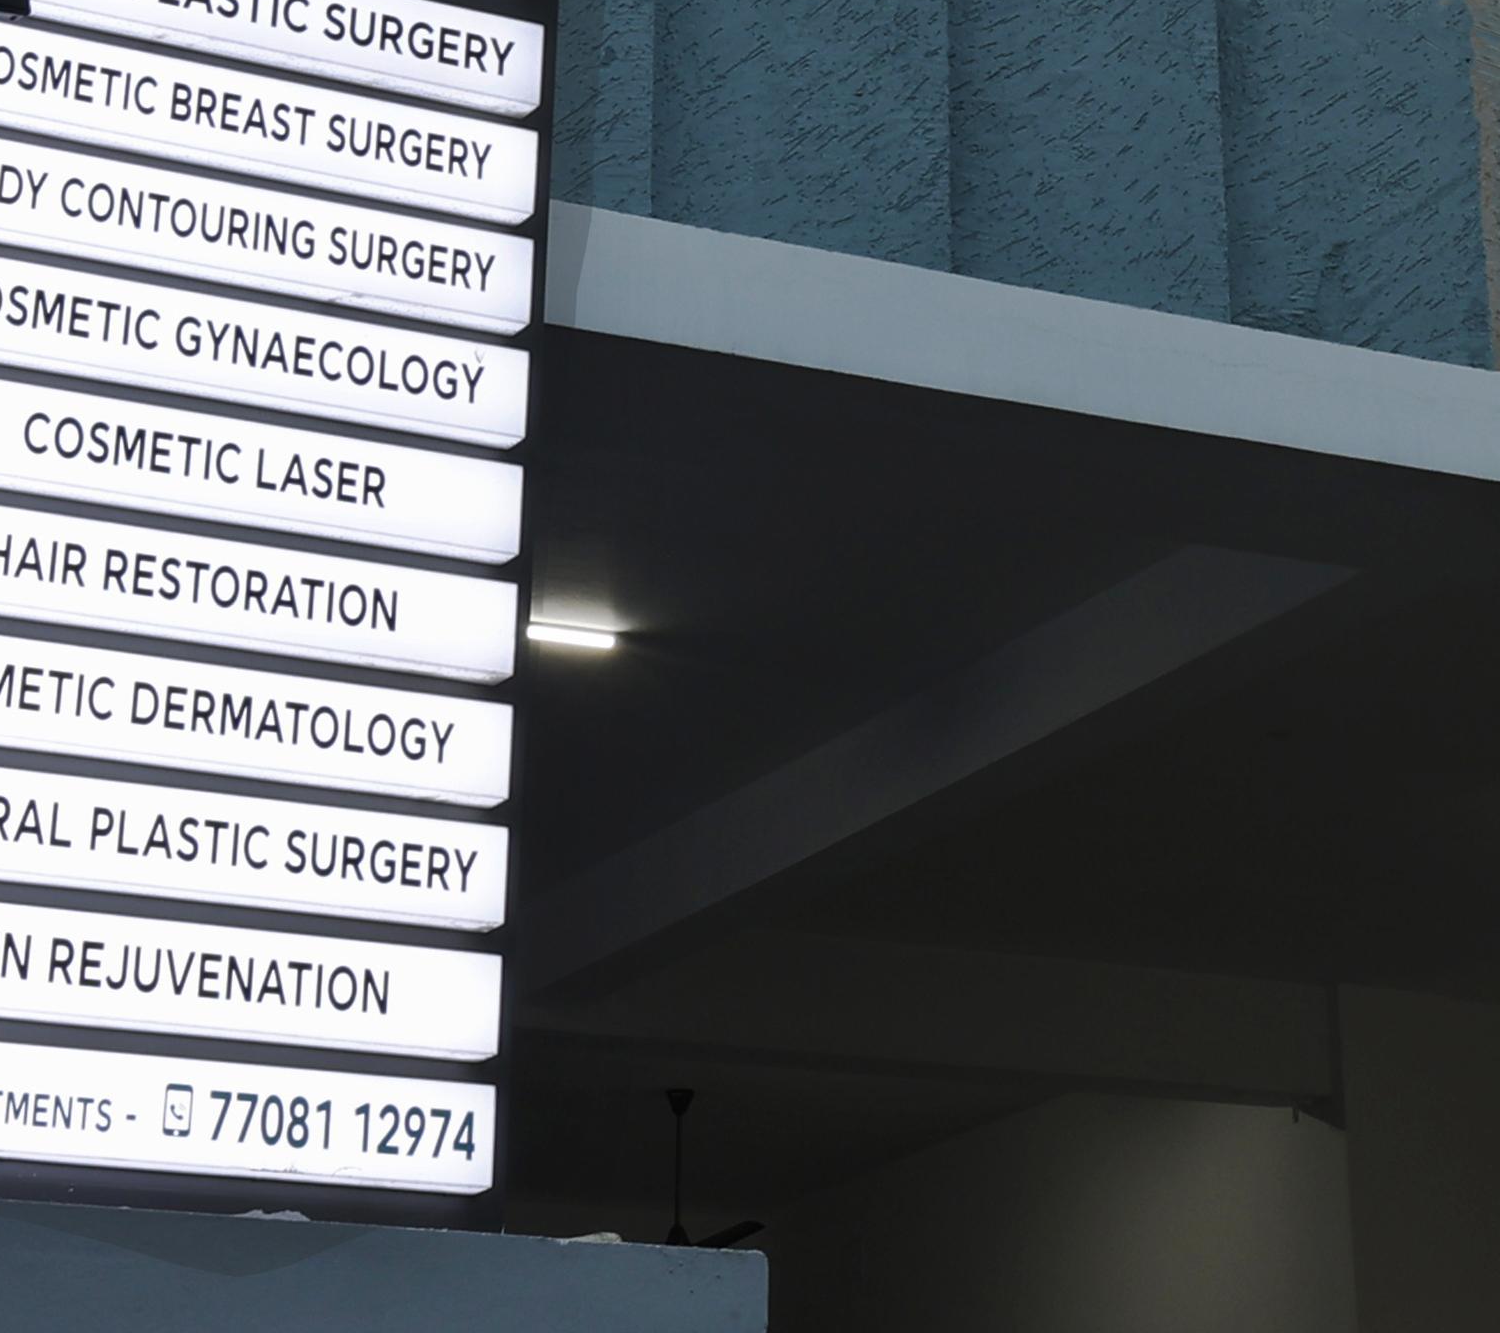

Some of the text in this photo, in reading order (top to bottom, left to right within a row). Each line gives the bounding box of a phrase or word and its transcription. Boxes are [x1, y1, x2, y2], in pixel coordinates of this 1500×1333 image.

[323, 3, 516, 77] SURGERY
[169, 83, 316, 147] BREAST
[327, 116, 493, 181] SURGERY
[59, 177, 317, 261] CONTOURING
[327, 227, 497, 293] SURGERY
[173, 316, 484, 405] GYNAECOLOGY
[23, 411, 388, 508] COSMETIC LASER
[102, 549, 398, 633] RESTORATION
[130, 681, 455, 764] DERMATOLOGY
[89, 806, 269, 871] PLASTIC
[283, 831, 480, 894] SURGERY
[47, 938, 391, 1016] REJUVENATION
[208, 1088, 334, 1150] 77081
[353, 1102, 477, 1163] 12974
